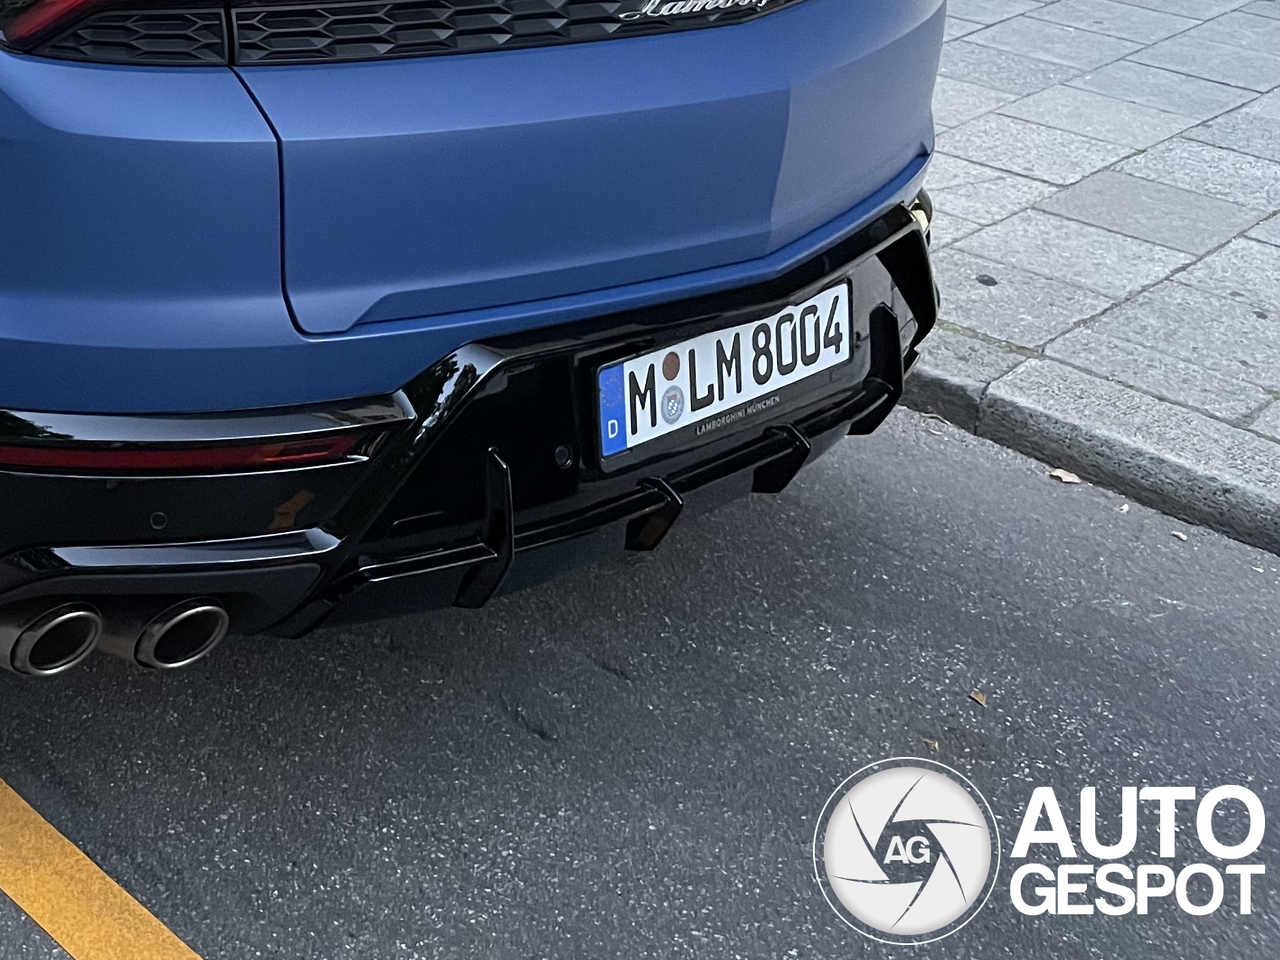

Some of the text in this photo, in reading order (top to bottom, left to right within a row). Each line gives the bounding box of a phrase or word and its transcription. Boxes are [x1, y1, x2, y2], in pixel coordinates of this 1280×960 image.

[607, 295, 844, 439] D M LM 8004
[696, 395, 780, 436] LAMBORGHINI MÜNCHEN
